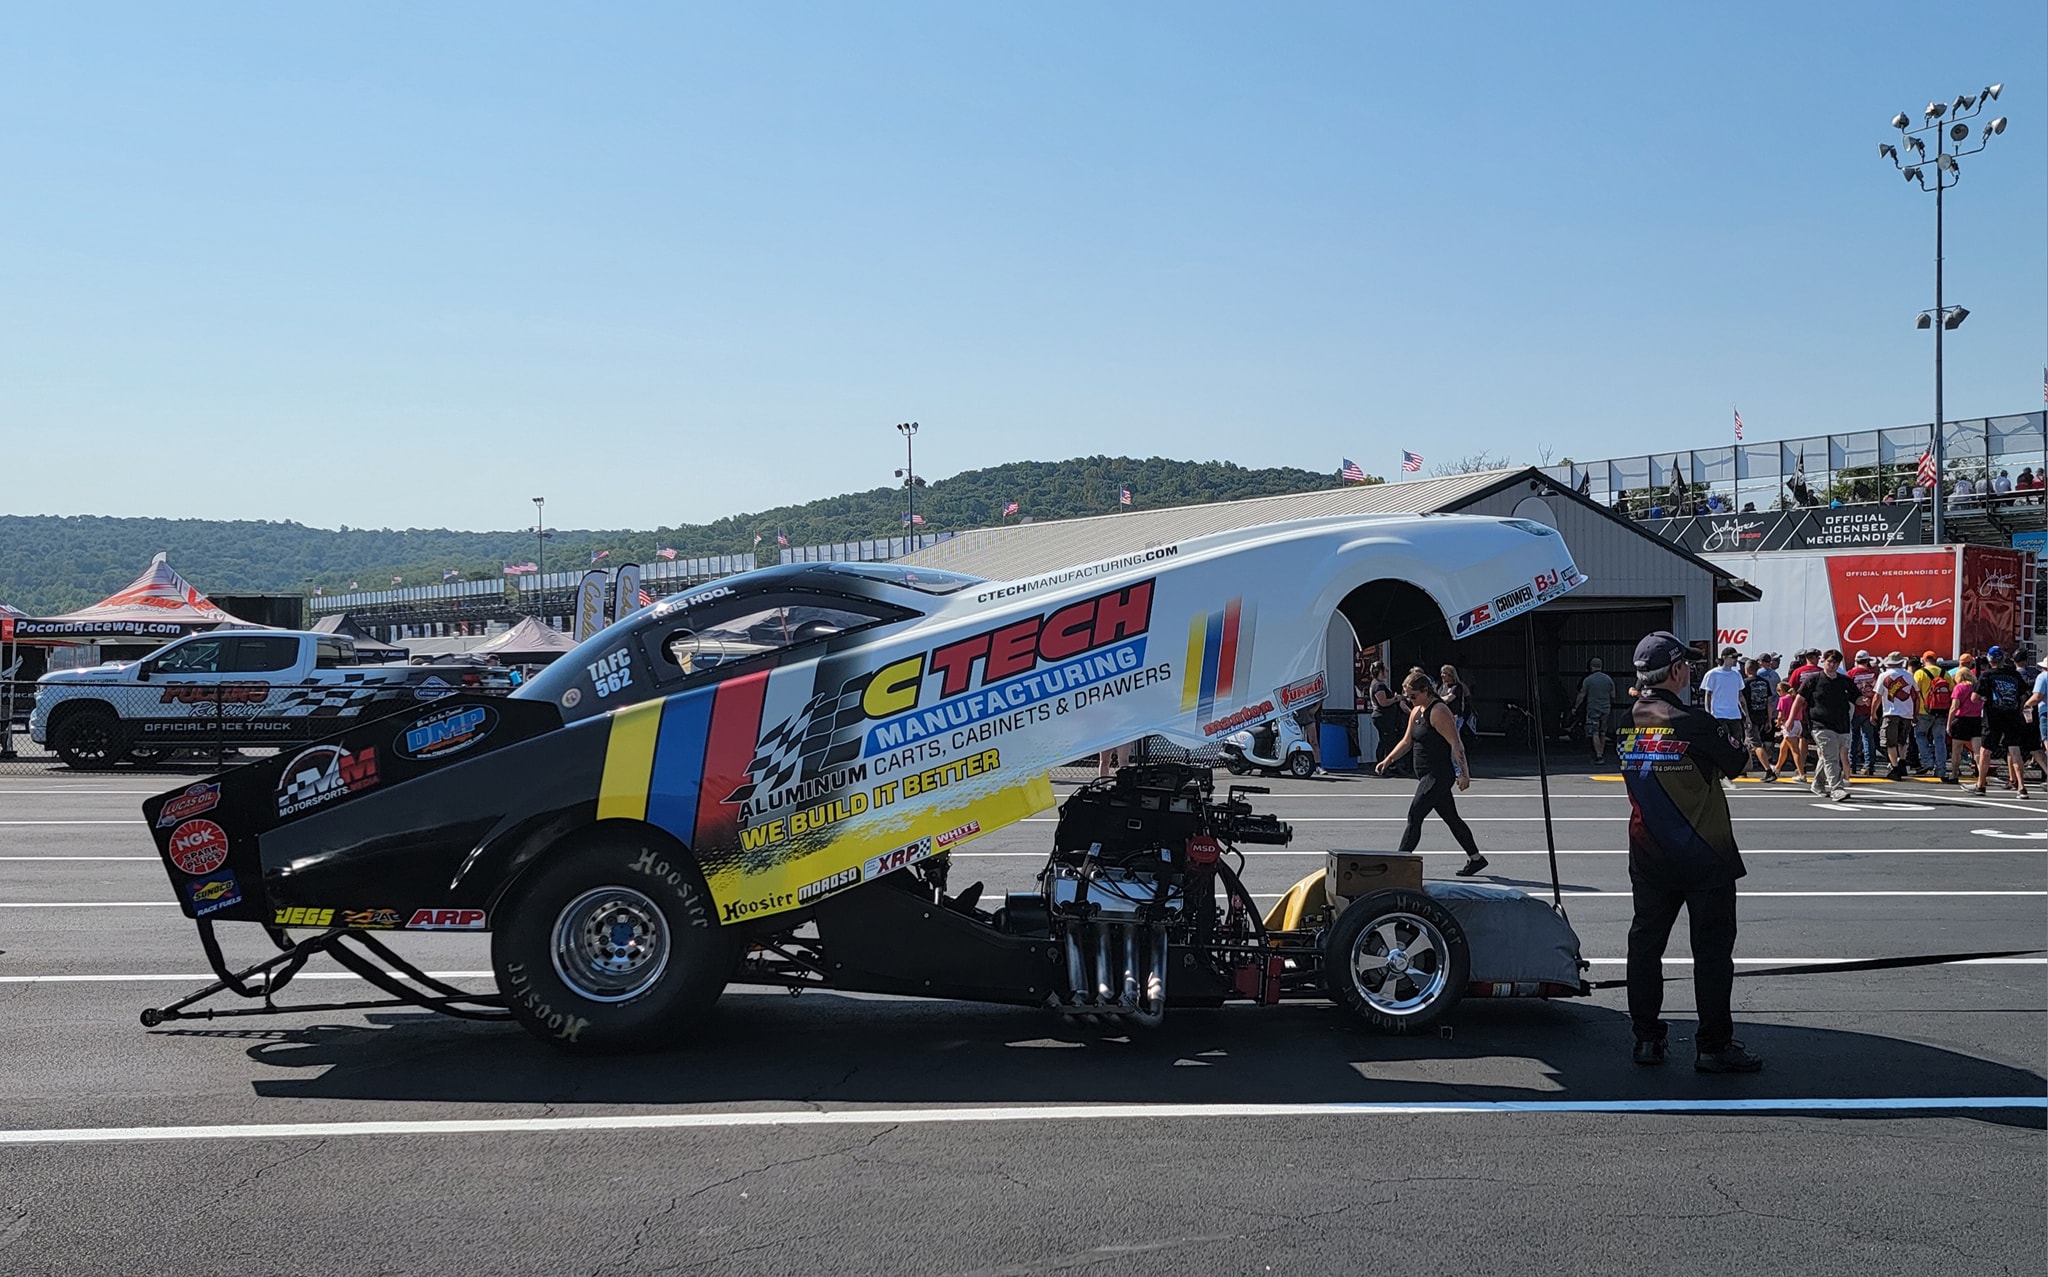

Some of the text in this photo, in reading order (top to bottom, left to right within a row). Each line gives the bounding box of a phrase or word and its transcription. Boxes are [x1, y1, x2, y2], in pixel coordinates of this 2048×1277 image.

[1822, 523, 1889, 535] LICENSED
[1825, 513, 1886, 525] OFFICIAL
[1806, 532, 1905, 545] MERCHANDISE
[977, 545, 1179, 604] CTECHMANUFACTURING.COM
[689, 586, 735, 605] HOOL
[1495, 586, 1534, 612] CROWER
[16, 621, 181, 635] PoconoRaceway.com
[1456, 605, 1491, 634] JE
[1909, 617, 1947, 625] RACING
[587, 648, 632, 681] TAFC
[595, 668, 633, 698] 562
[875, 645, 1138, 750] MANUFACTURING
[144, 723, 204, 731] OFFICIAL
[246, 722, 291, 730] TRUCK
[406, 707, 486, 753] DMP
[1646, 727, 1675, 735] BETTER
[737, 663, 1172, 822] ALUMINUM CARTS, CABINETS & DRAWERS
[166, 796, 198, 815] LUCAS
[198, 791, 214, 803] OIL
[279, 786, 350, 817] MOTORSPORTS
[739, 748, 1000, 852] WE BUILD IT BETTER
[176, 828, 215, 851] NGK
[937, 820, 980, 843] WHITE
[184, 844, 218, 861] SPARK
[877, 843, 921, 874] XRP
[1192, 844, 1216, 853] MSD
[187, 853, 221, 869] PLUGS
[195, 880, 233, 900] SUNOCO
[628, 847, 710, 928] Hoosier
[798, 866, 861, 903] MOROSO
[197, 895, 242, 917] RACE FUELS
[275, 907, 336, 926] JEGS
[409, 910, 485, 925] ARP
[722, 890, 794, 922] Hoosier
[507, 962, 592, 1043] Hoosier
